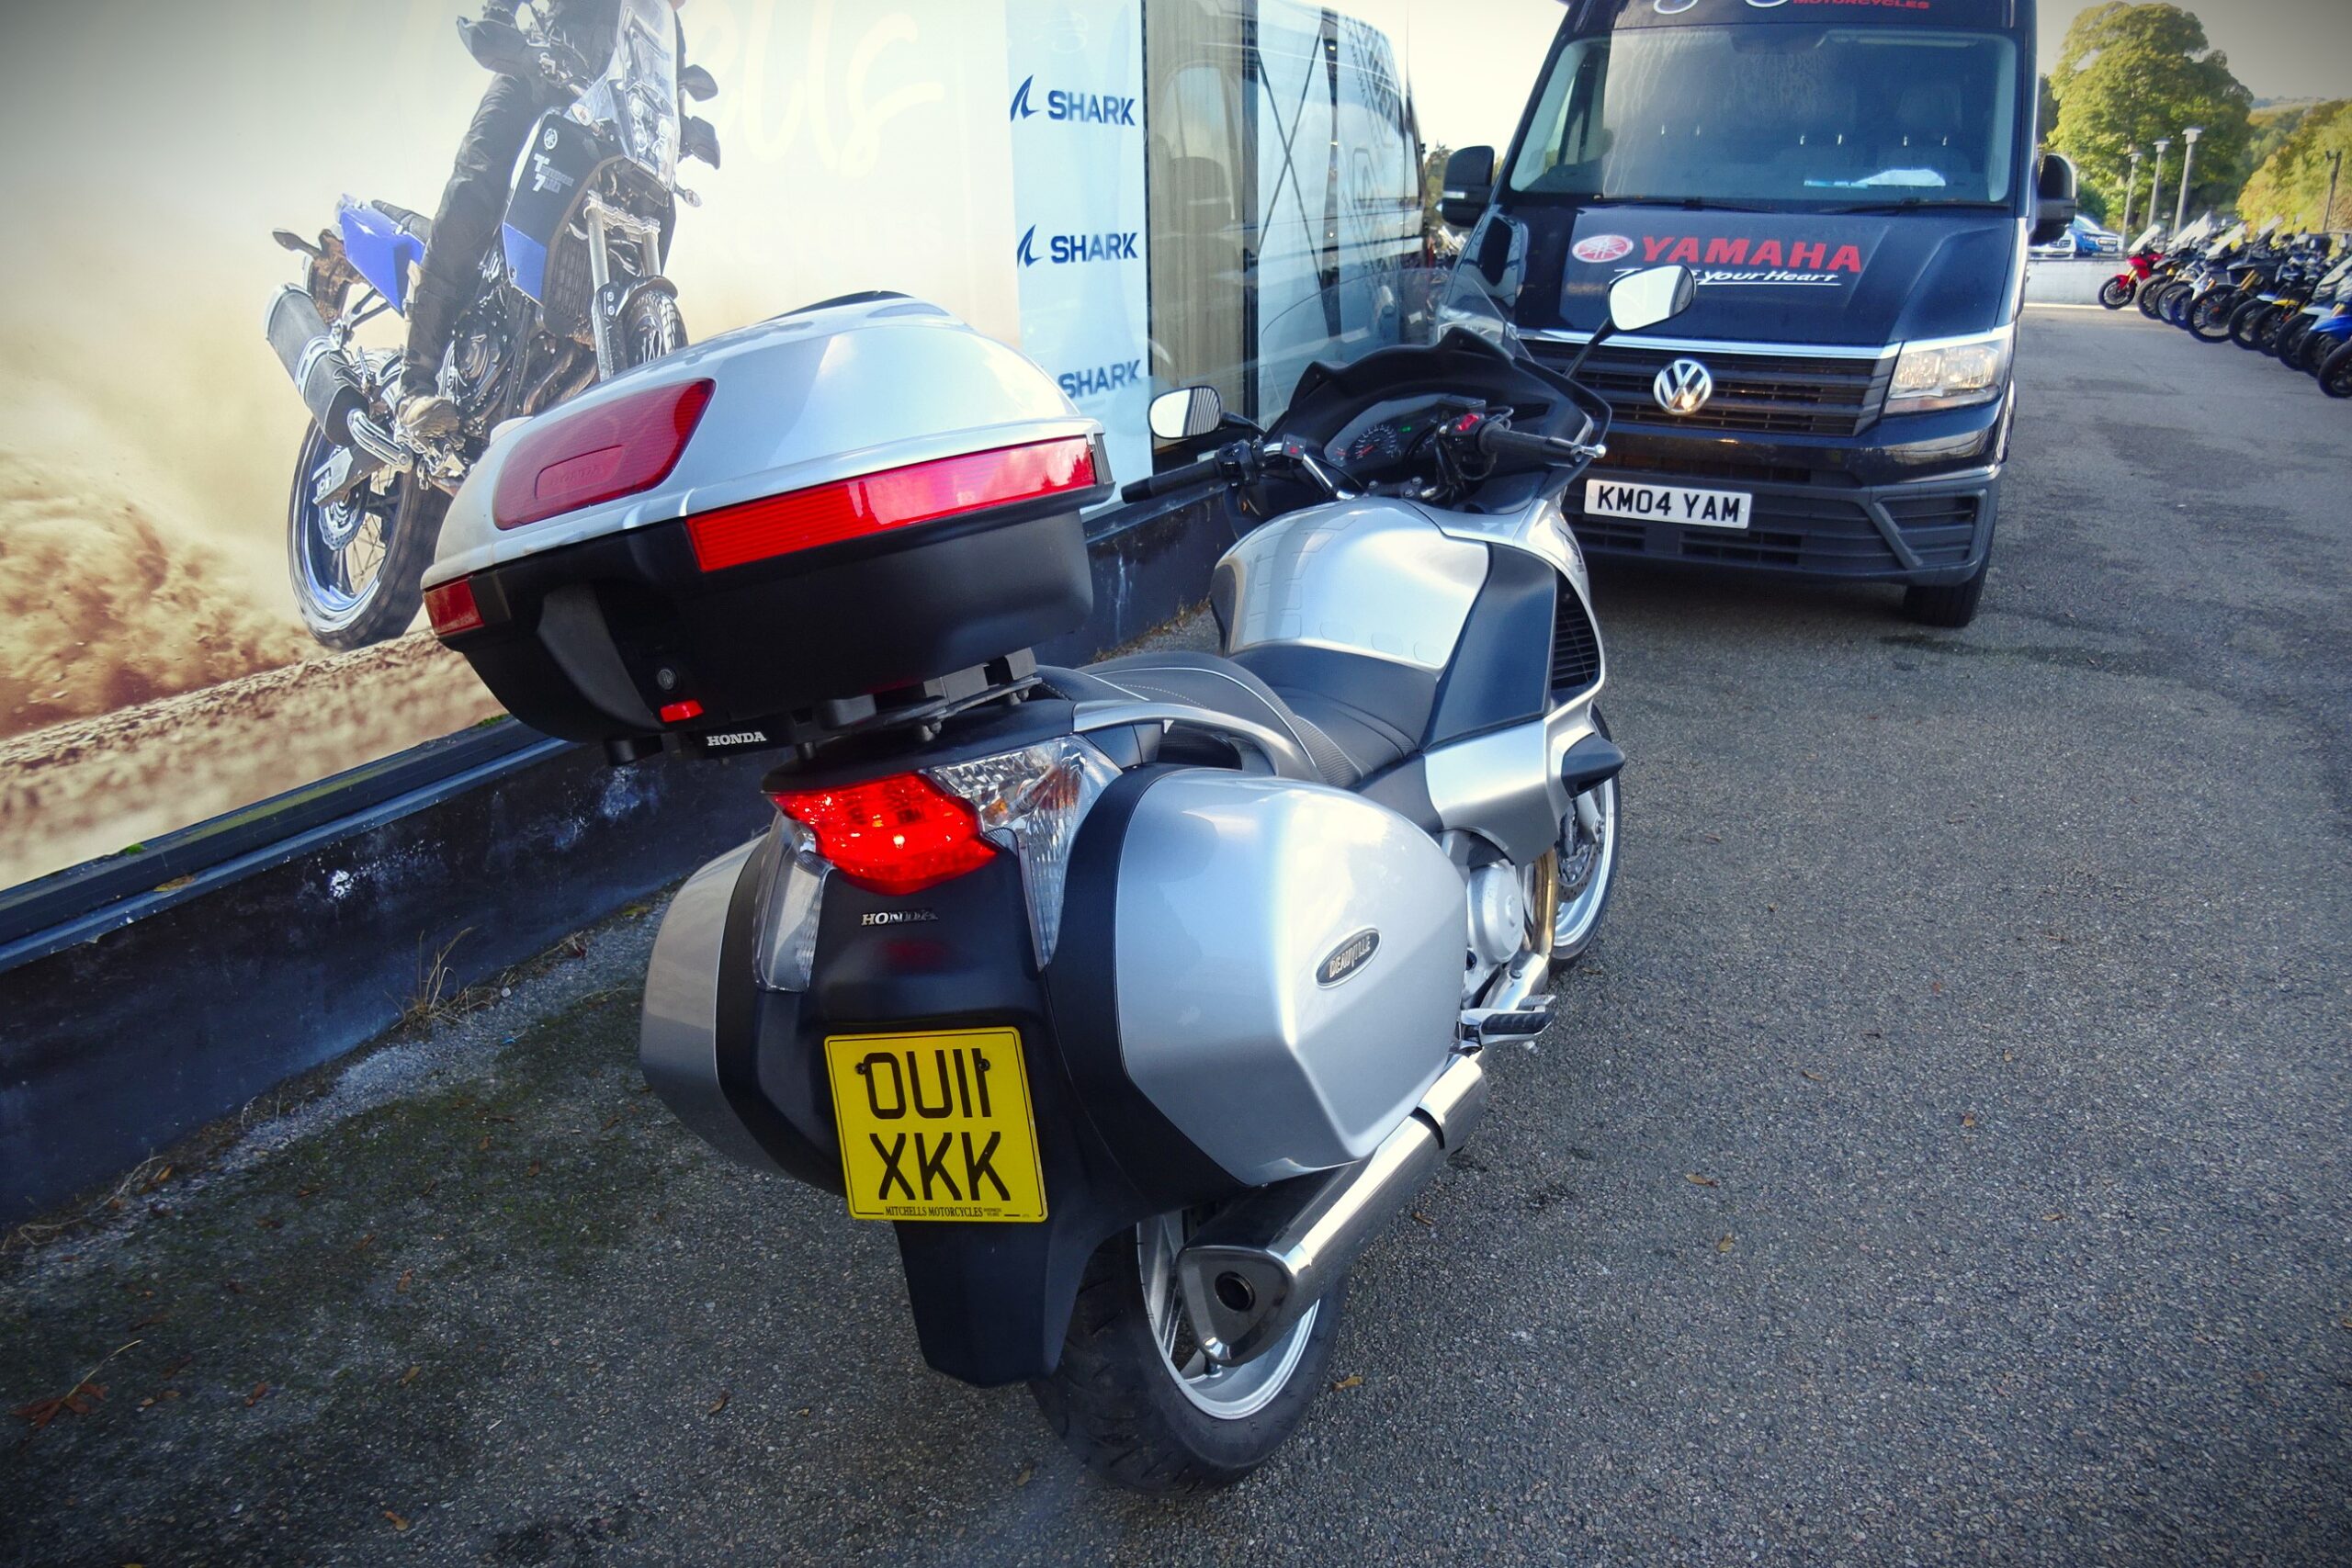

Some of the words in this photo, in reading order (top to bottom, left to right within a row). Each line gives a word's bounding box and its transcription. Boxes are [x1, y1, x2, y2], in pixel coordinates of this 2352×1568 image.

[1047, 90, 1136, 126] SHARK
[1050, 232, 1138, 264] SHARK
[1643, 236, 1861, 273] YAMAHA
[1764, 270, 1838, 282] Heart
[1057, 359, 1140, 399] SHARK
[1597, 485, 1671, 516] KM04
[1684, 493, 1740, 523] YAM
[707, 731, 767, 746] HONDA
[861, 910, 938, 926] HONDA
[863, 1048, 992, 1120] OU11
[869, 1132, 1012, 1201] XKK
[886, 1206, 927, 1217] MITCHELLS
[928, 1206, 983, 1217] MOTORCYCLES
